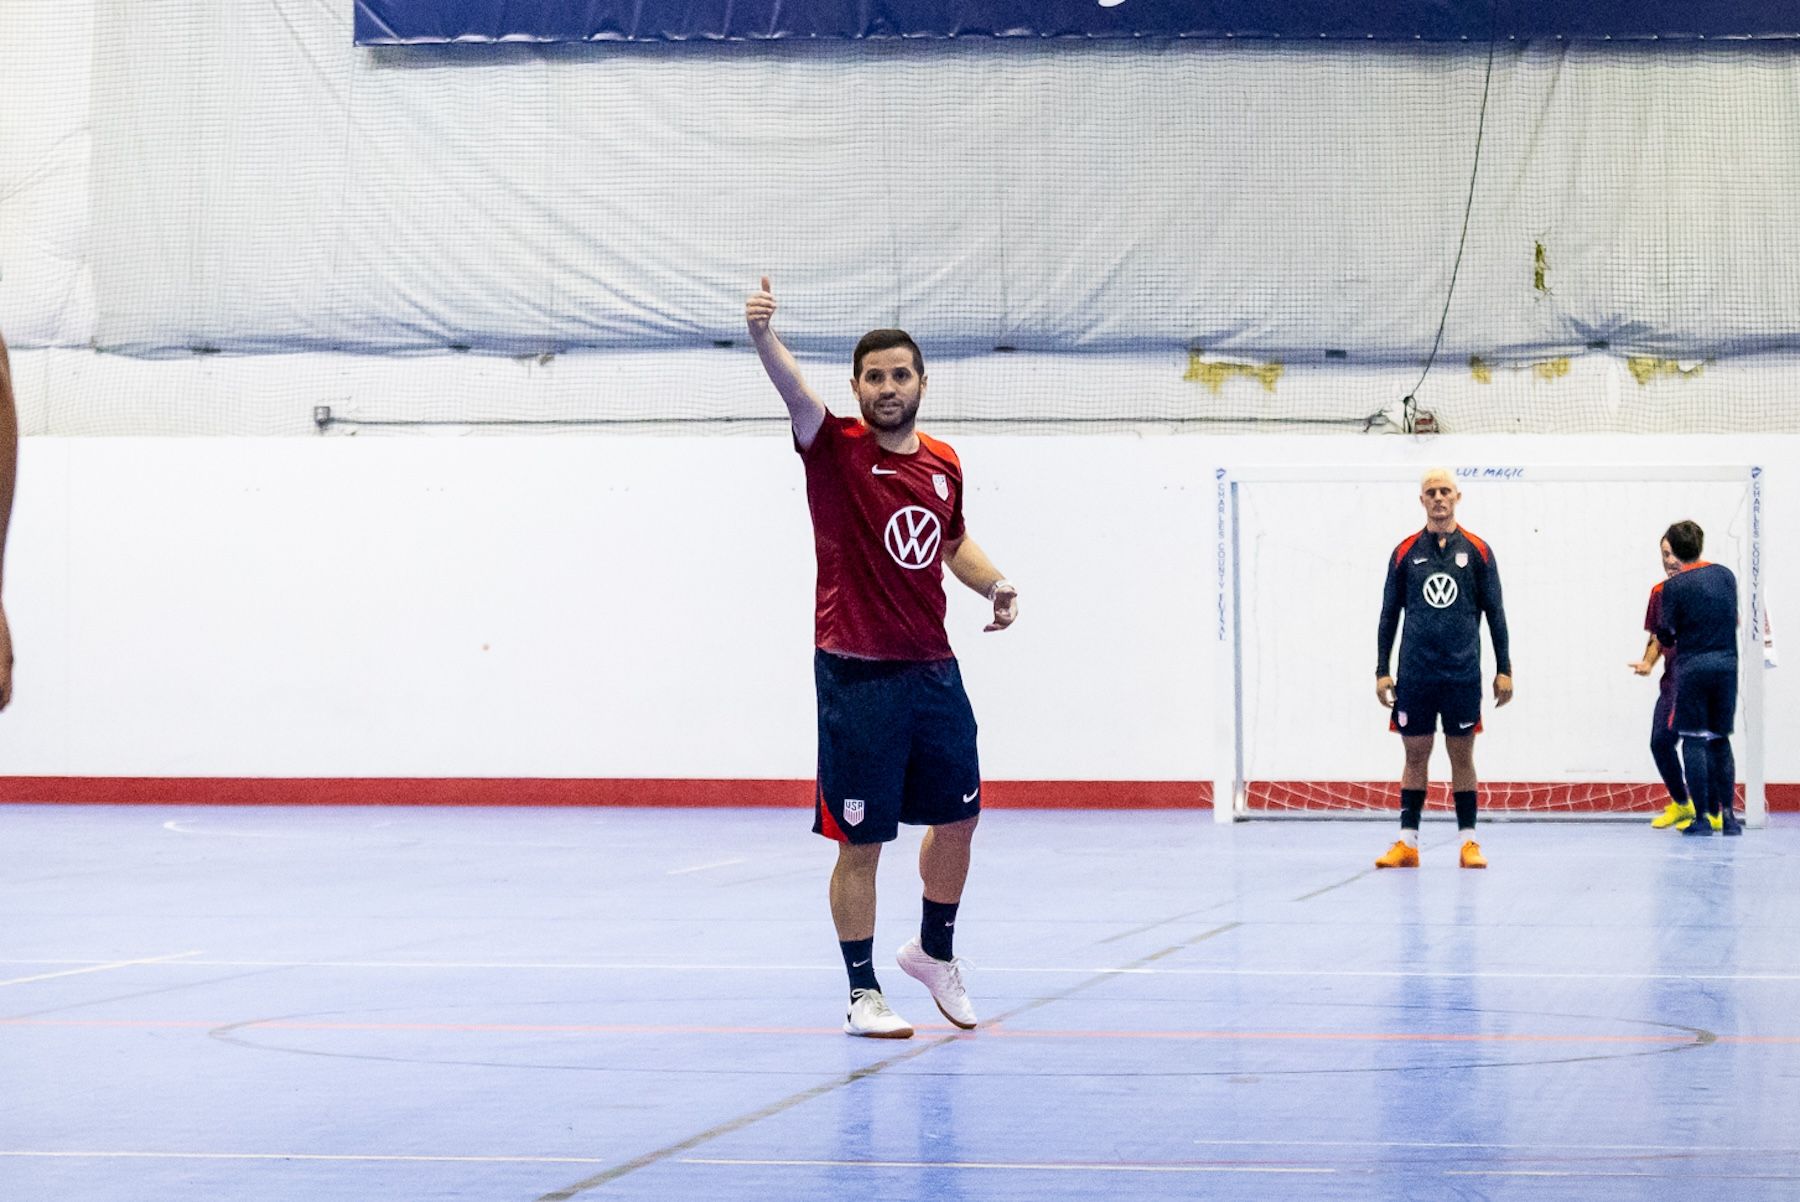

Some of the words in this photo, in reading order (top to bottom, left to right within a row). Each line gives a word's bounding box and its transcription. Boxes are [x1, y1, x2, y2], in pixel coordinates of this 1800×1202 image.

[1455, 467, 1478, 477] LUE
[1482, 467, 1524, 480] MAGIC
[1217, 482, 1225, 539] CHARLES
[1752, 481, 1760, 539] CHARLES
[884, 505, 941, 570] VW
[1217, 542, 1226, 589] COUNTY
[1752, 542, 1760, 590] COUNTY
[1423, 573, 1458, 608] VW
[1752, 593, 1760, 641] FUTSAL
[845, 801, 863, 811] USA
